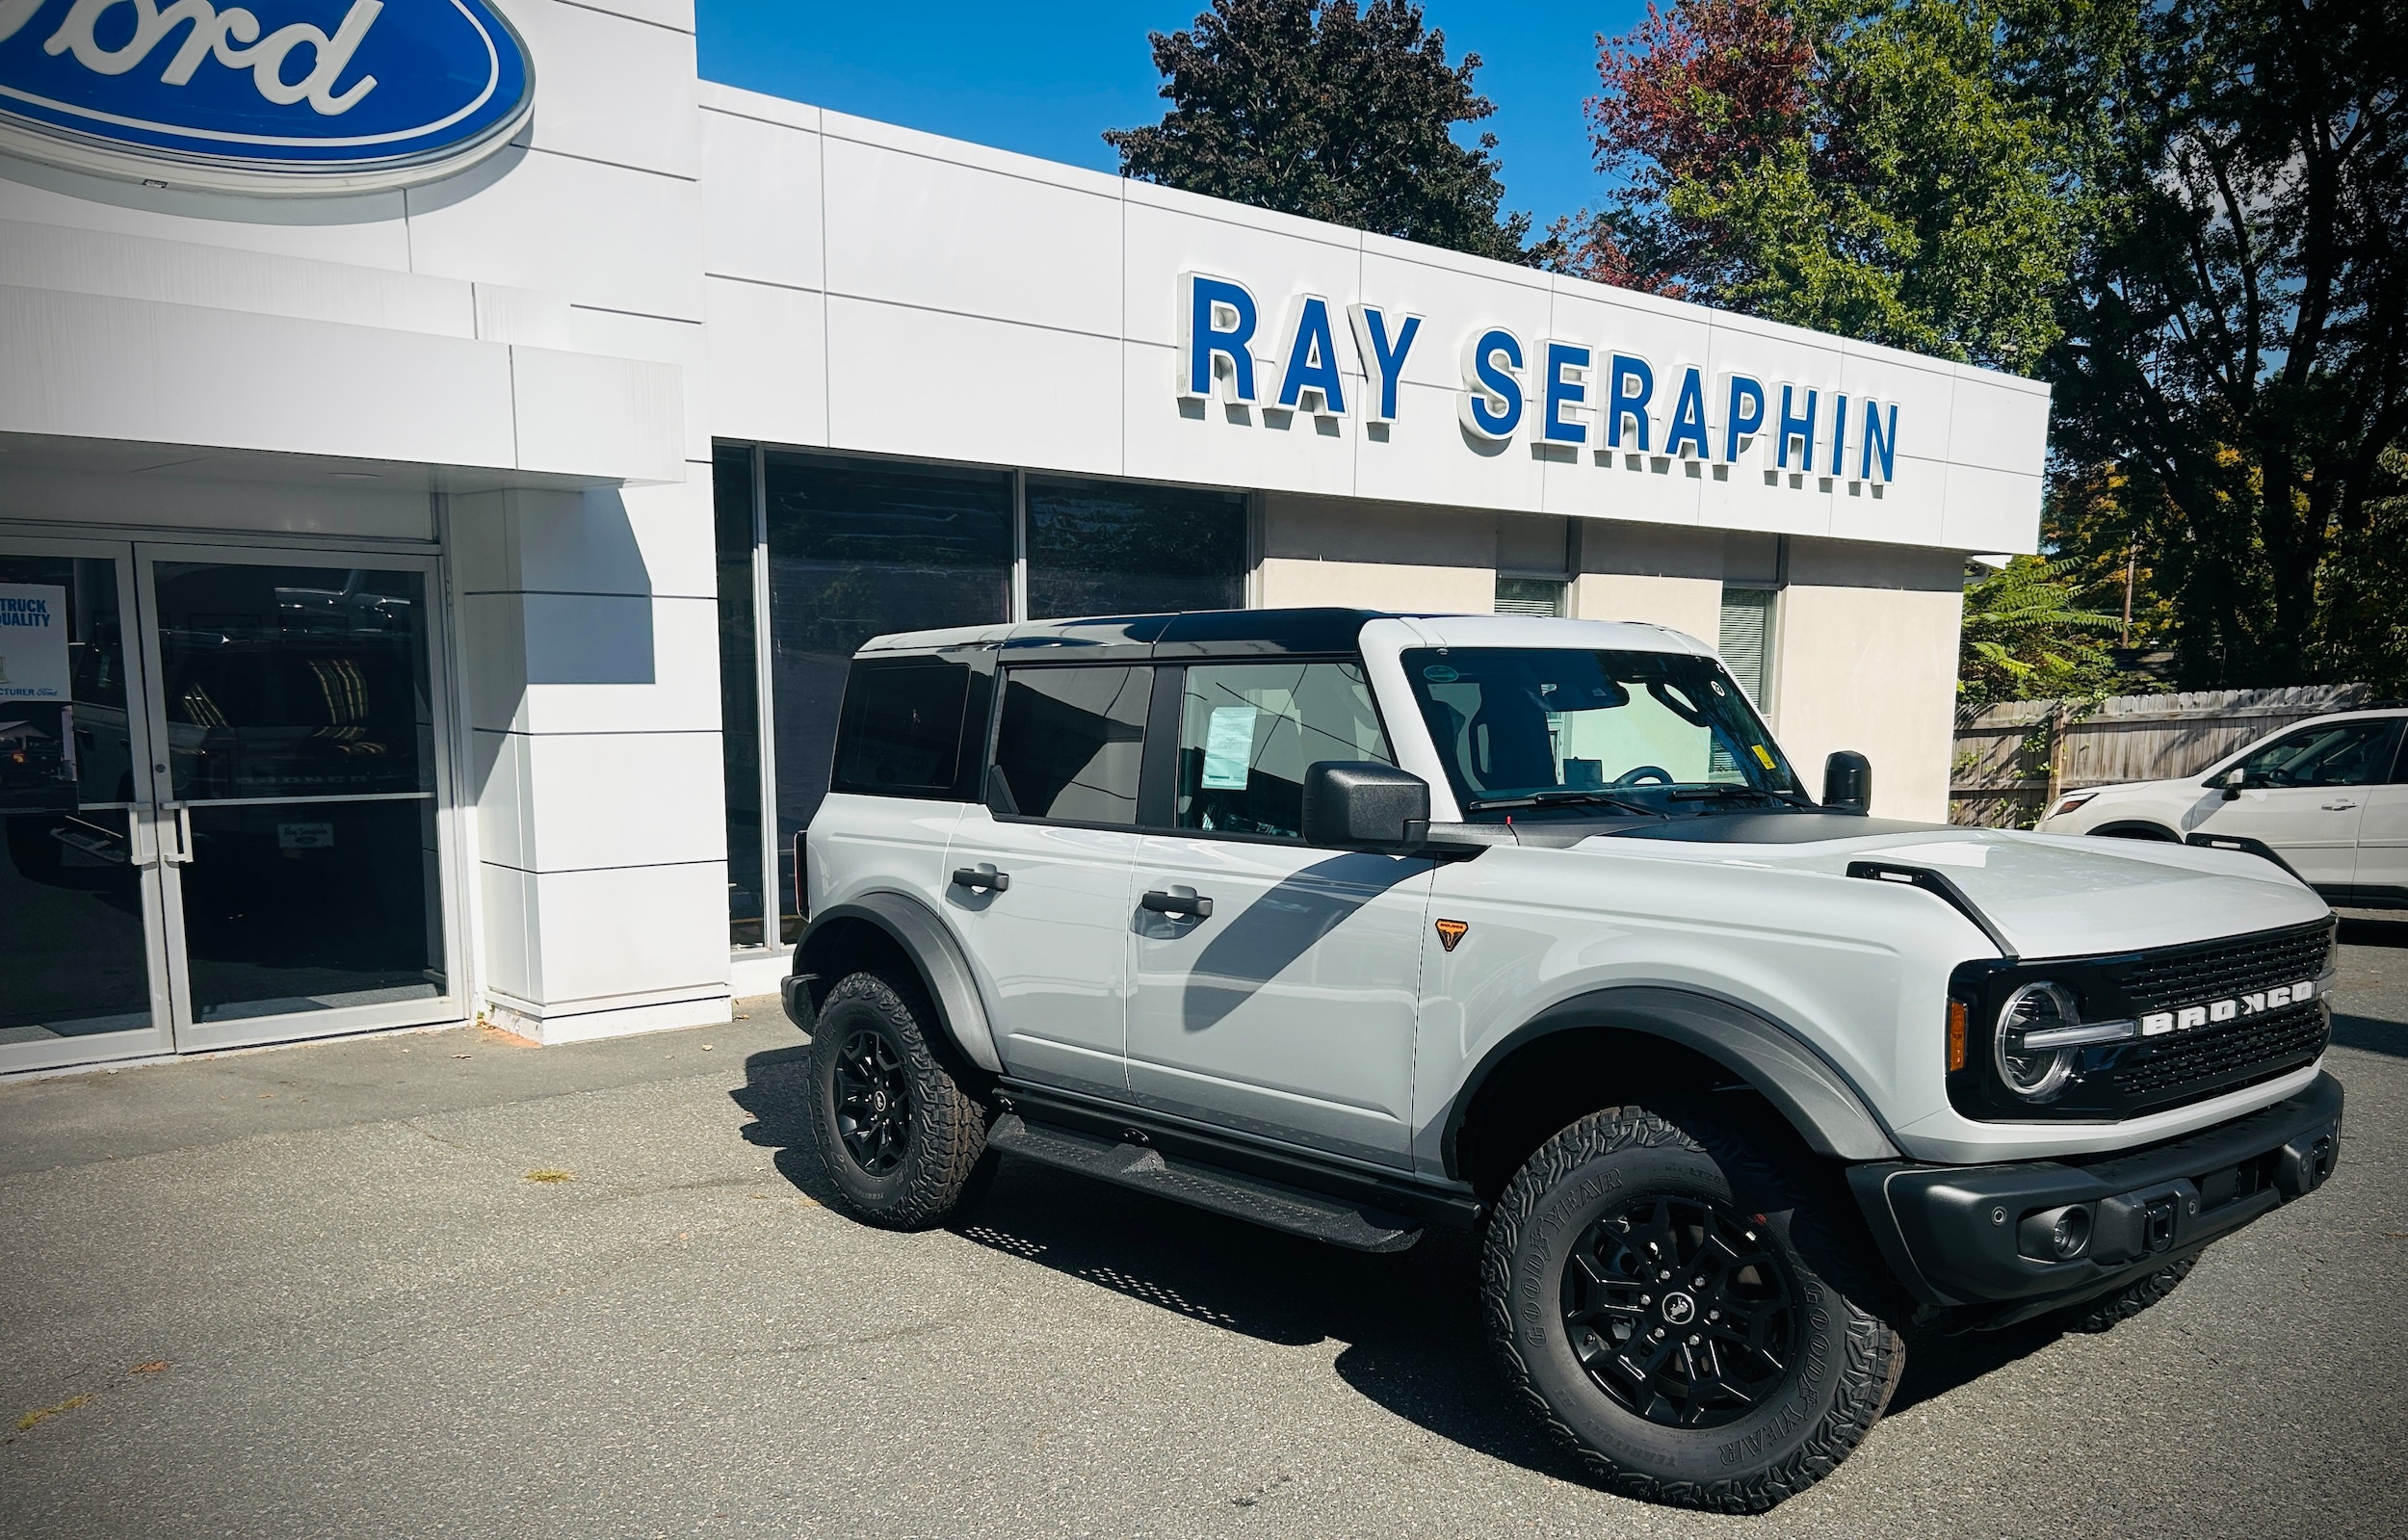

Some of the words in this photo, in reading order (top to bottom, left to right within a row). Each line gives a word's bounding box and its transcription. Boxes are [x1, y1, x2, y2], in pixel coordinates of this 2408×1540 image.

[0, 0, 385, 116] ord
[1183, 271, 1426, 427] RAY
[1462, 326, 1900, 486] SERAPHIN
[0, 598, 46, 613] TRUCK
[0, 613, 50, 628] UALITY
[37, 688, 58, 696] Ford
[2142, 980, 2314, 1036] BRONCO
[1521, 1167, 1623, 1348] GOODYEAR
[1719, 1280, 1830, 1467] GOODYEAR
